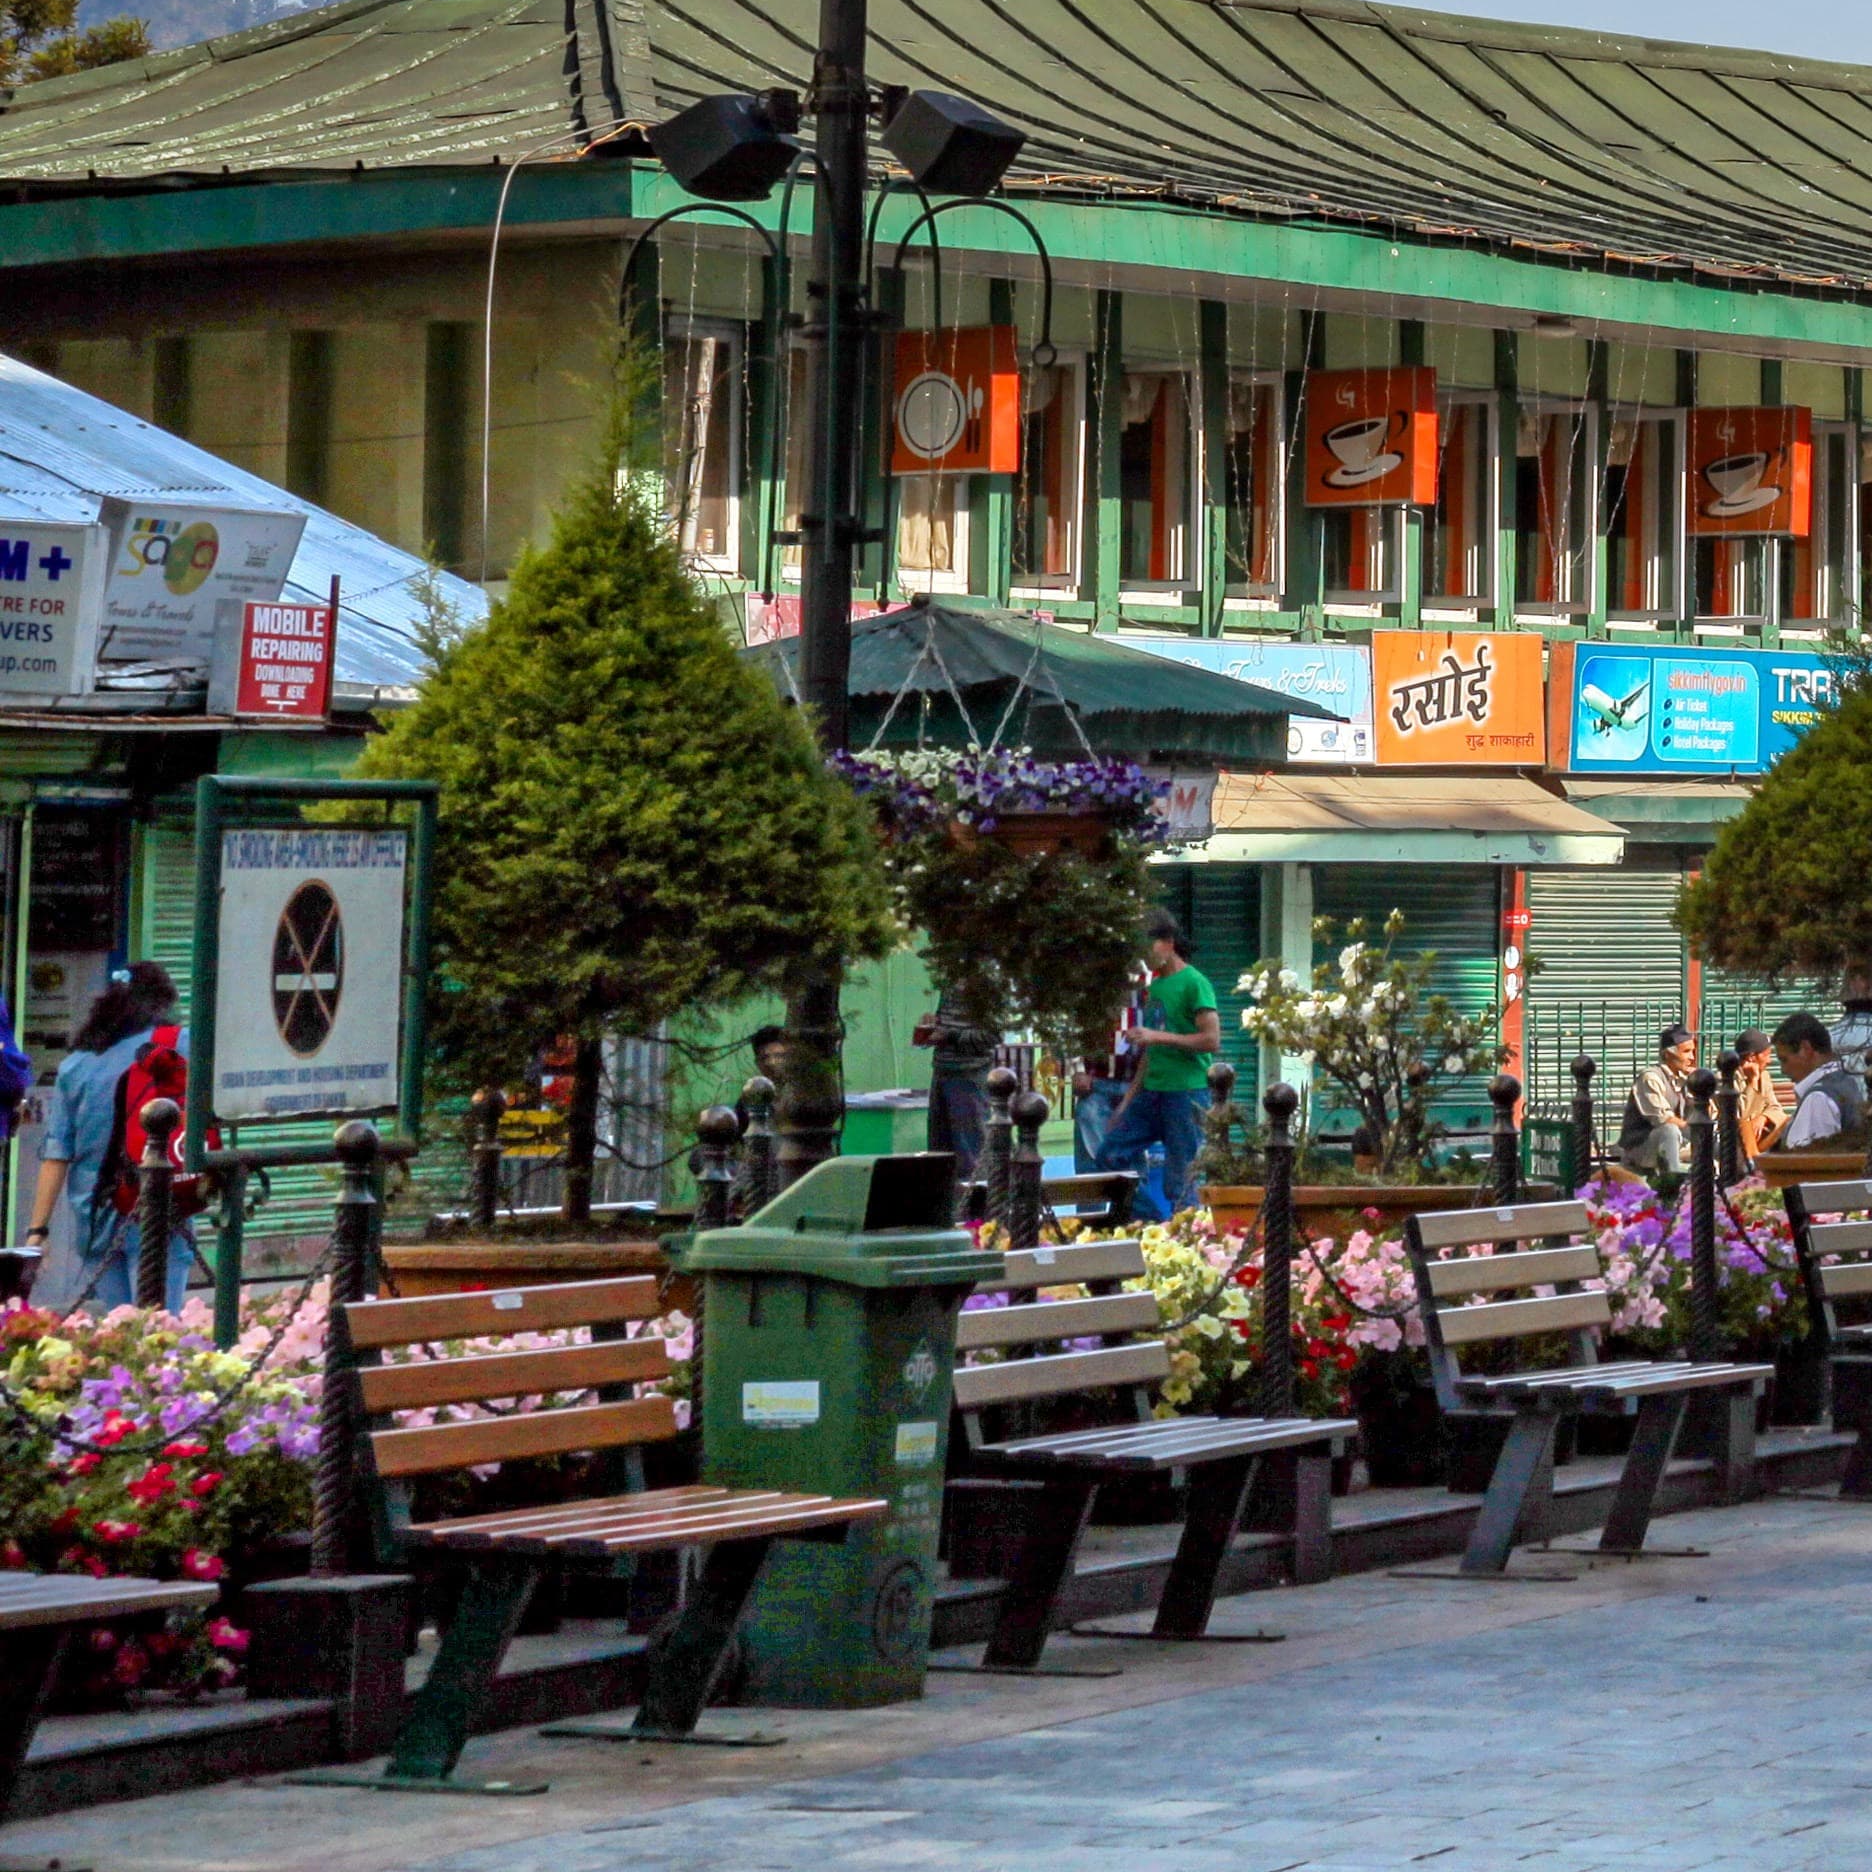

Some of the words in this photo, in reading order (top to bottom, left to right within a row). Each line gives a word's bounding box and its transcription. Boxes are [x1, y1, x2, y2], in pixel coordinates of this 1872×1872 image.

[30, 598, 65, 615] FOR
[253, 606, 326, 638] MOBILE
[251, 637, 324, 662] REPAIRING
[1392, 645, 1492, 732] रसोई
